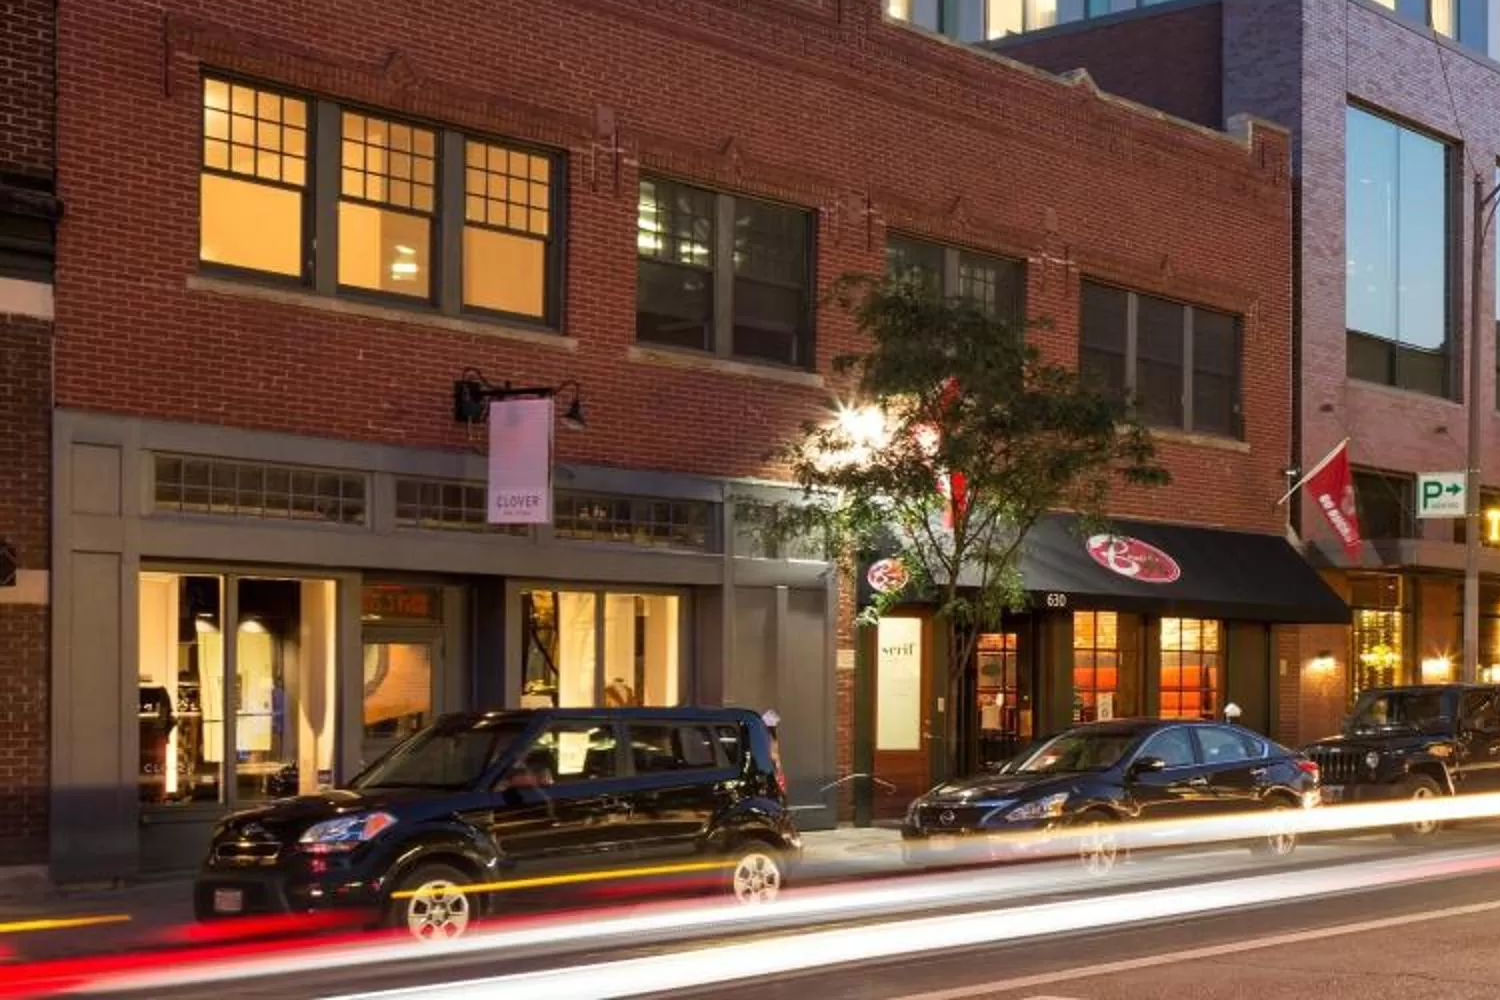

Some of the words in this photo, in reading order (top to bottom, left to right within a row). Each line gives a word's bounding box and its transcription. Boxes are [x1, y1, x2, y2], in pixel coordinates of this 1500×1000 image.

[496, 495, 541, 508] CLOVER
[1423, 481, 1442, 509] P
[1047, 594, 1067, 607] 630
